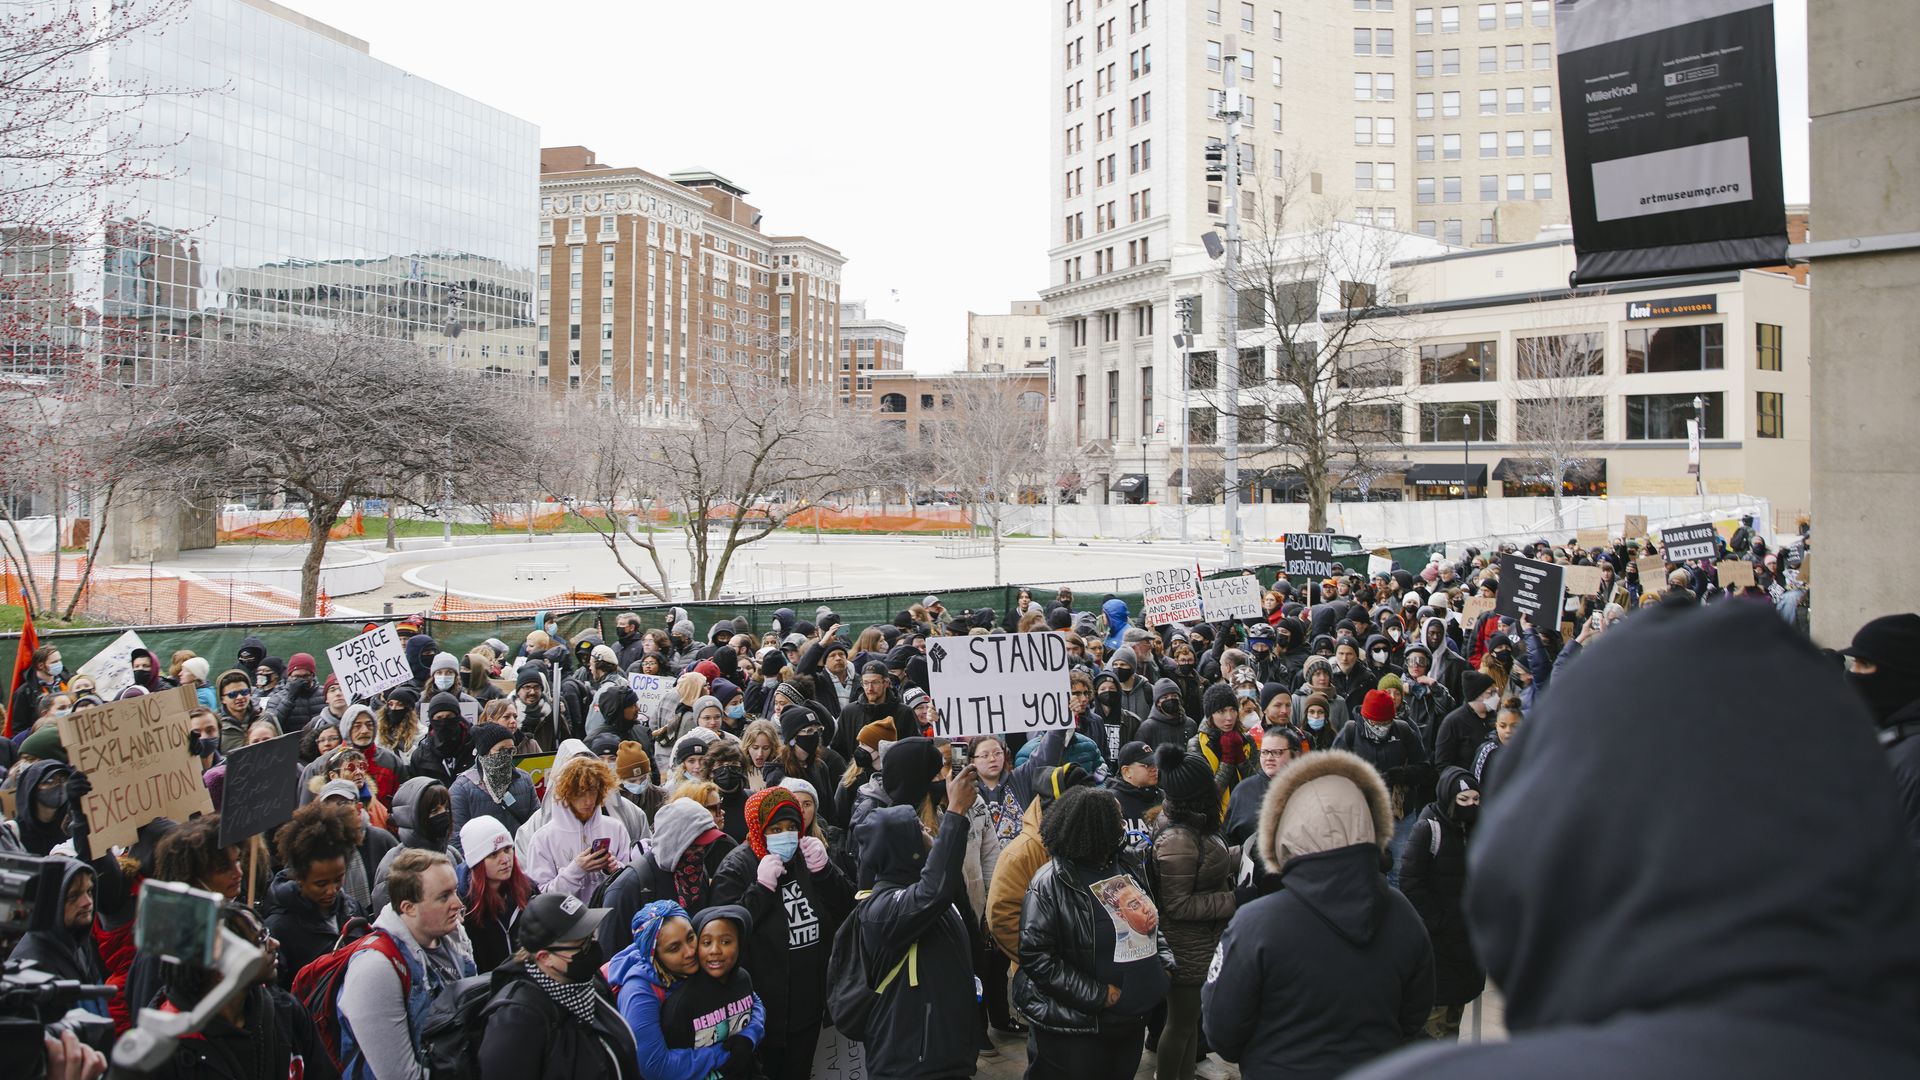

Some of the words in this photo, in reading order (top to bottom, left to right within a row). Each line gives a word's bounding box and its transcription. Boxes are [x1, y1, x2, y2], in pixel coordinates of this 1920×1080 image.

[1585, 82, 1638, 104] MillerKnoll
[1639, 182, 1740, 206] artmuseumgr.org
[1629, 302, 1652, 319] hni
[1652, 306, 1671, 315] RISK
[1672, 302, 1713, 313] ADVISORS
[1285, 534, 1331, 553] ABOLITION
[1663, 530, 1690, 545] BLACK
[1690, 527, 1713, 540] LIVES
[1673, 545, 1710, 559] MATTER
[1144, 568, 1192, 586] GRPD
[1202, 577, 1249, 591] BLACK
[1144, 582, 1192, 597] PROTECTS
[1146, 589, 1196, 606] MURDERERS
[1209, 586, 1248, 599] LIVES
[1147, 607, 1200, 624] THEMSELVES
[1149, 604, 1167, 614] AND
[1170, 599, 1198, 611] SERVES
[1206, 604, 1257, 620] MATTER
[335, 628, 390, 661] JUSTICE
[969, 633, 1067, 674] STAND
[354, 649, 379, 668] FOR
[344, 655, 408, 694] PATRICK
[632, 675, 660, 691] COPS
[68, 708, 120, 746] THERE
[138, 697, 162, 729] NO
[932, 694, 1007, 737] WITH
[1022, 690, 1073, 728] YOU
[79, 719, 192, 775] EXPLANATION
[87, 761, 197, 834] EXECUTION
[692, 1005, 728, 1032] DEMON
